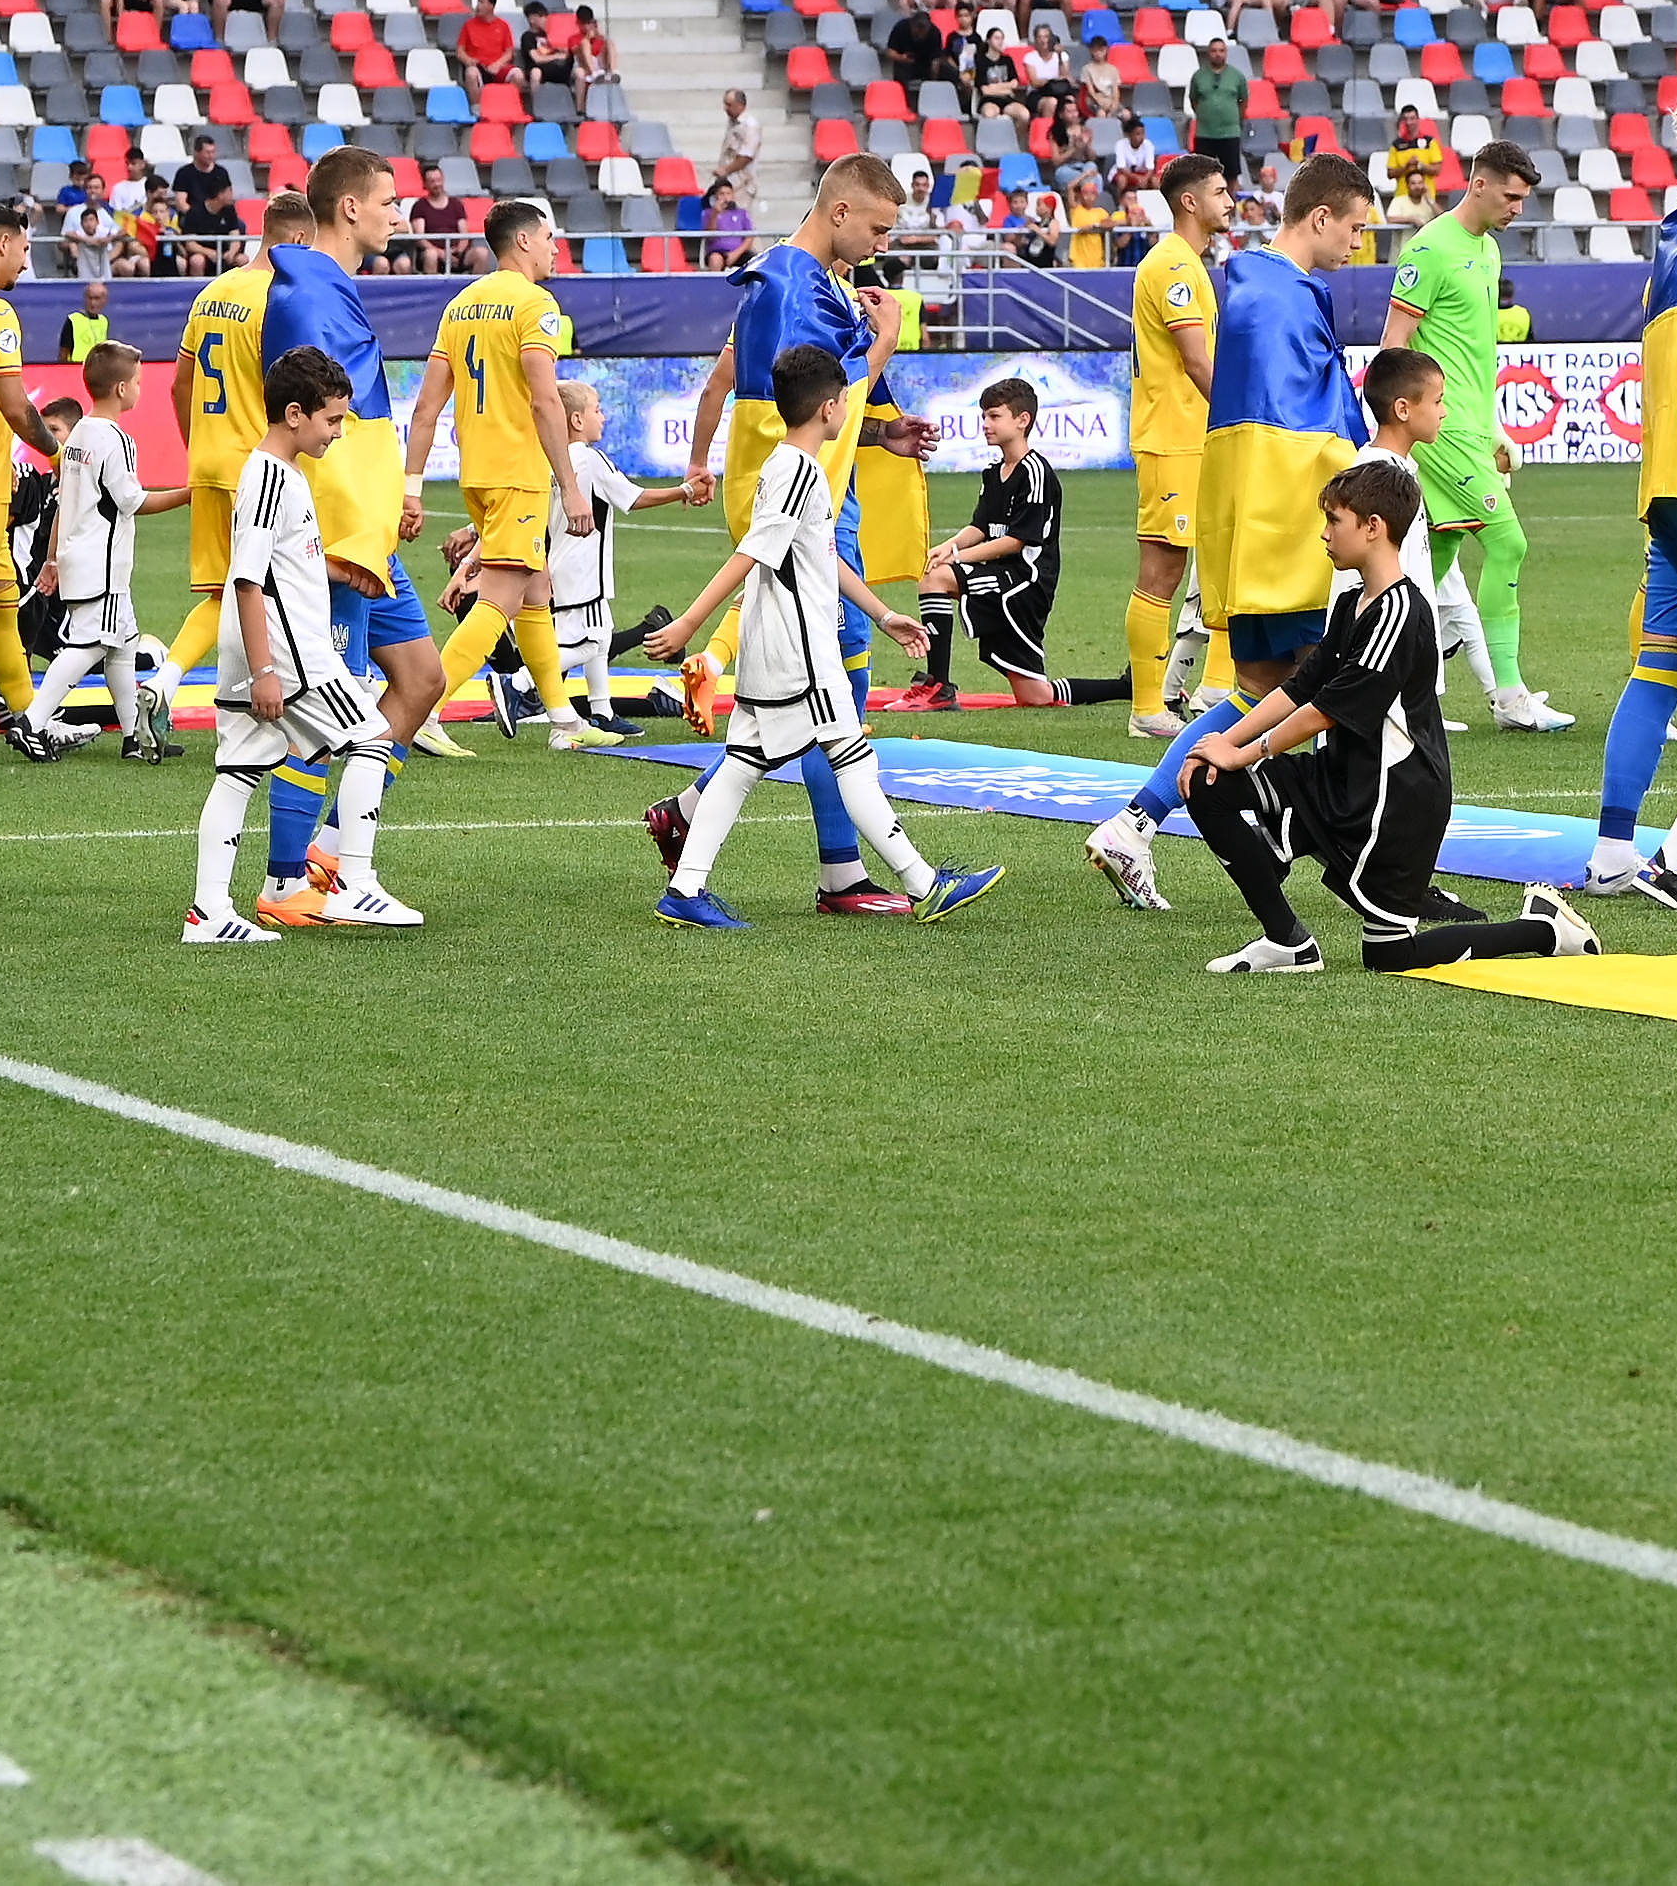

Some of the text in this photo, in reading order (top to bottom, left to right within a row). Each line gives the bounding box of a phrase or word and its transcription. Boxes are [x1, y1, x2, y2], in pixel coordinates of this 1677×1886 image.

[197, 332, 227, 414] 5
[464, 334, 484, 414] 4
[1566, 353, 1640, 369] RADIO
[940, 413, 1109, 440] BUVINA
[1523, 442, 1641, 460] HIT RADIO
